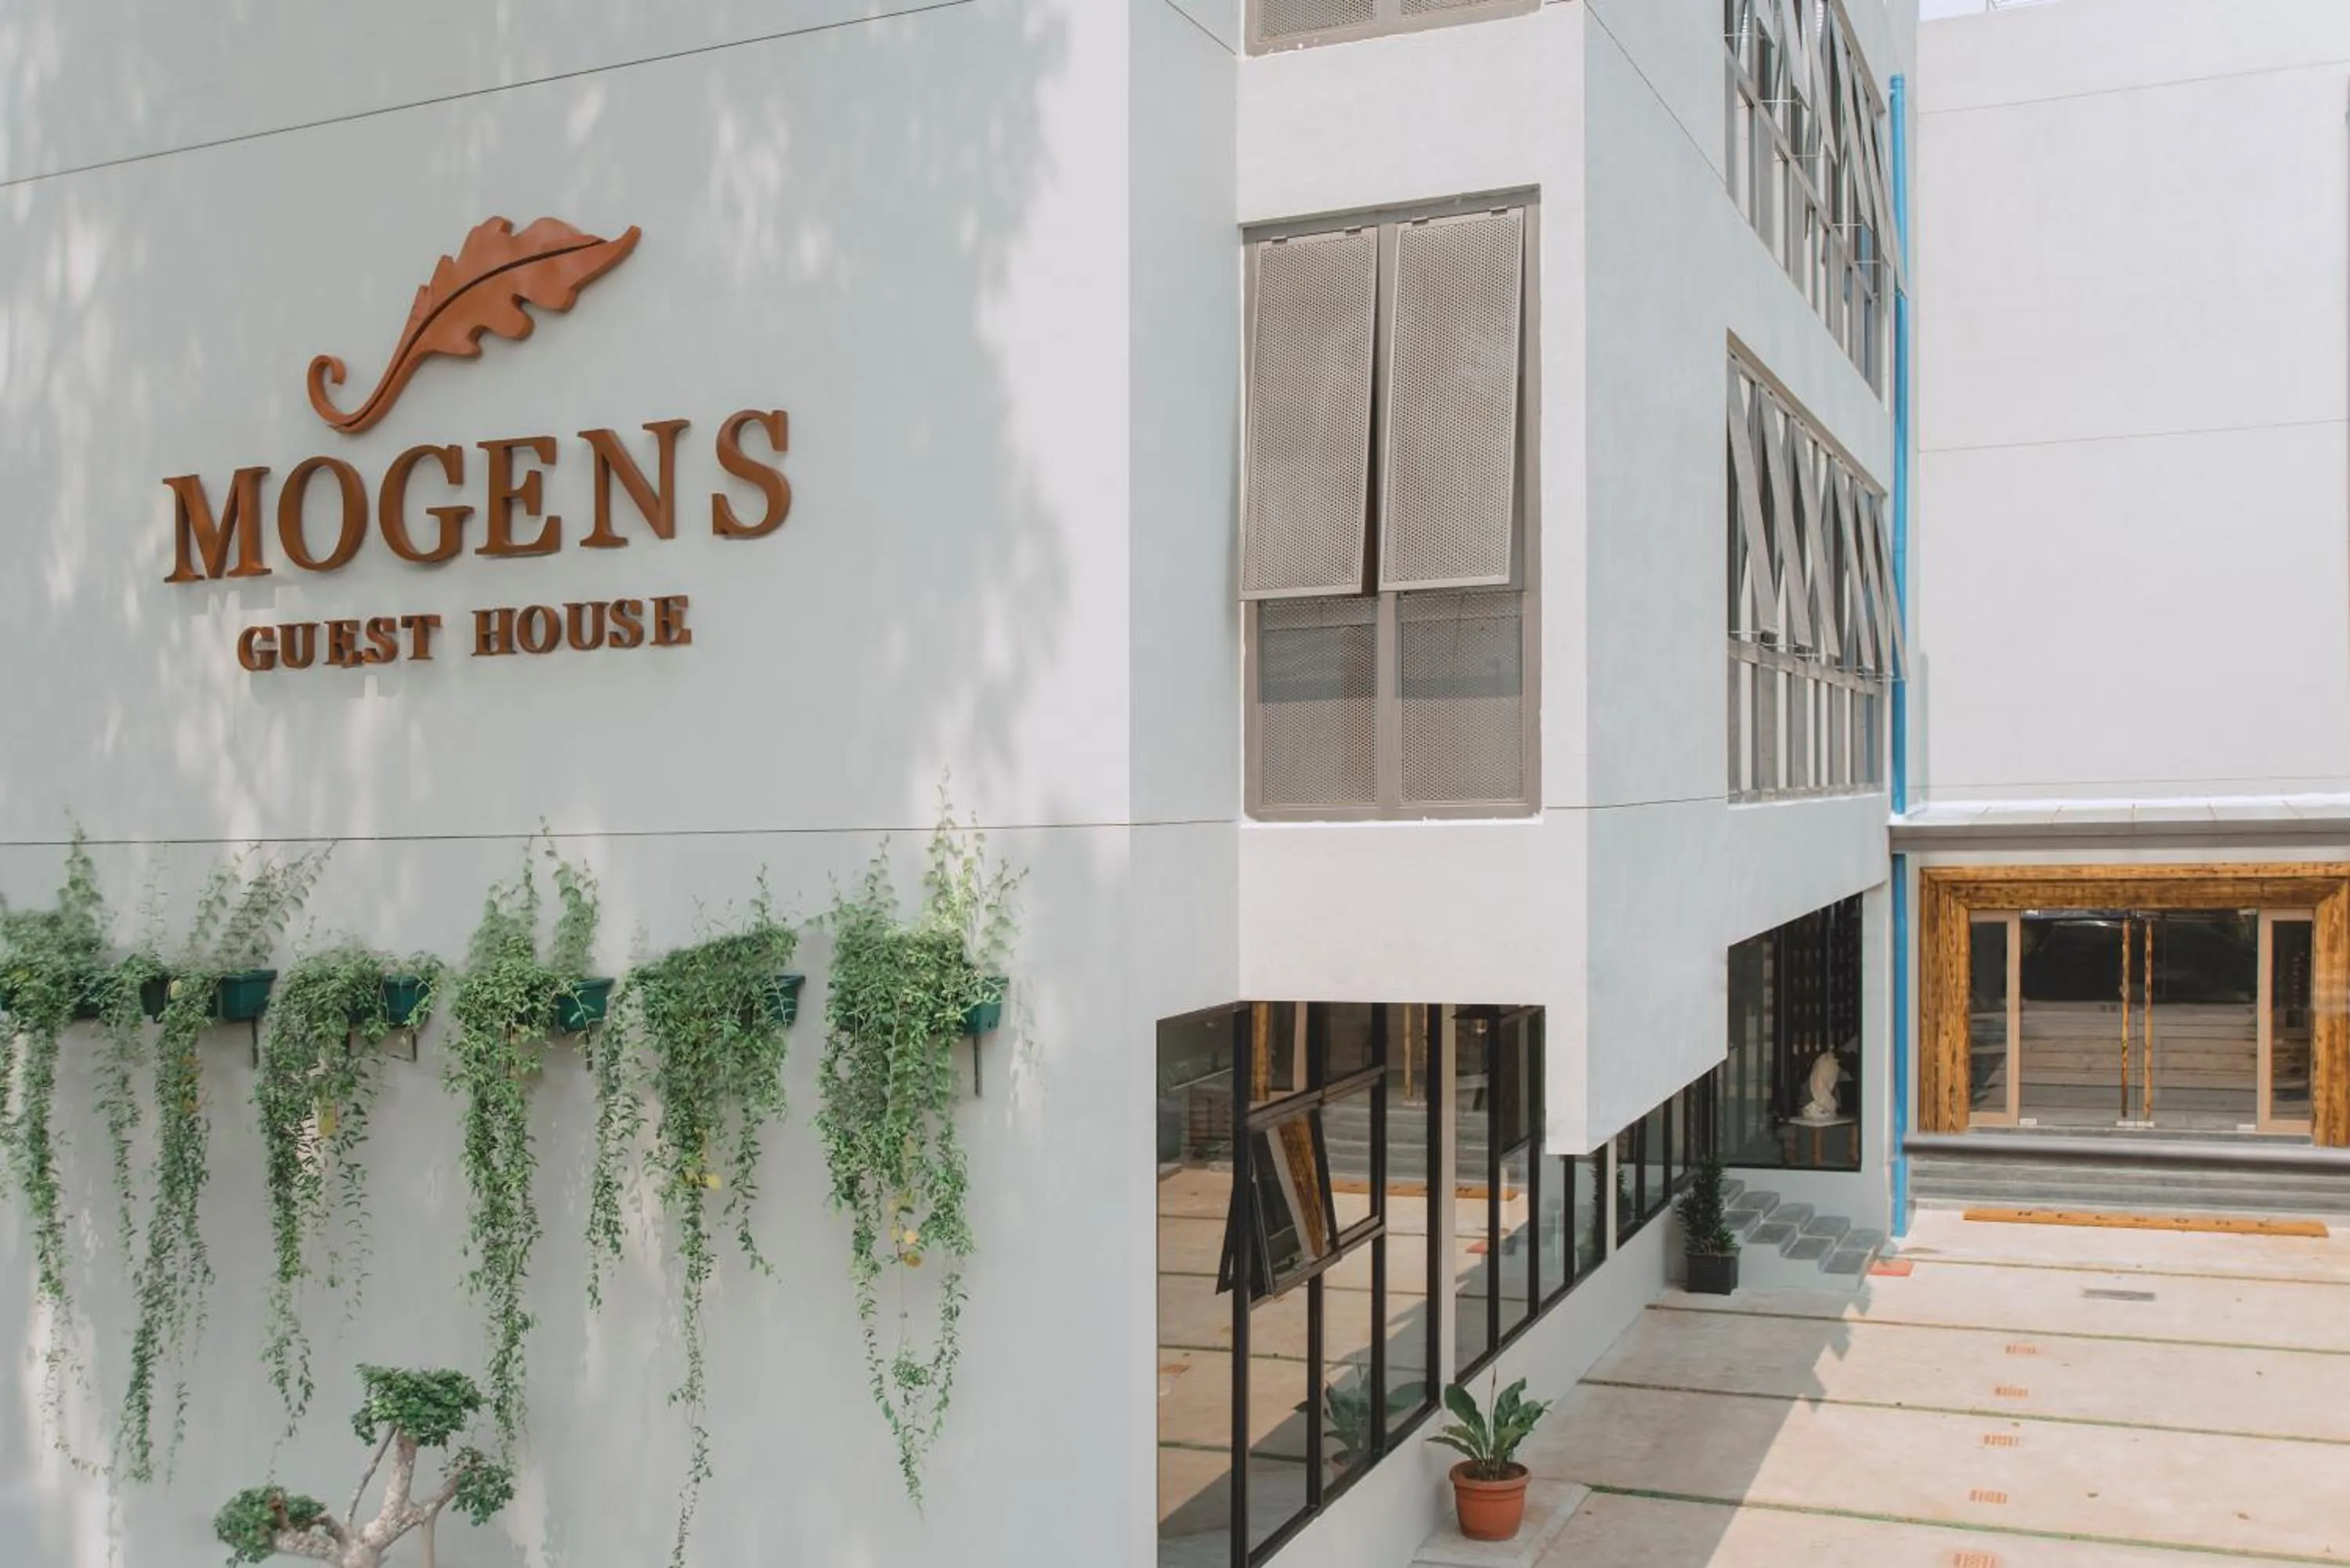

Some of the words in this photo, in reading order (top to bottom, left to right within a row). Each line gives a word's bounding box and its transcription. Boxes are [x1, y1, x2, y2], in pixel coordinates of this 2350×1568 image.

[161, 409, 792, 585] MOGENS
[236, 614, 443, 673] GUEST
[472, 595, 693, 656] HOUSE
